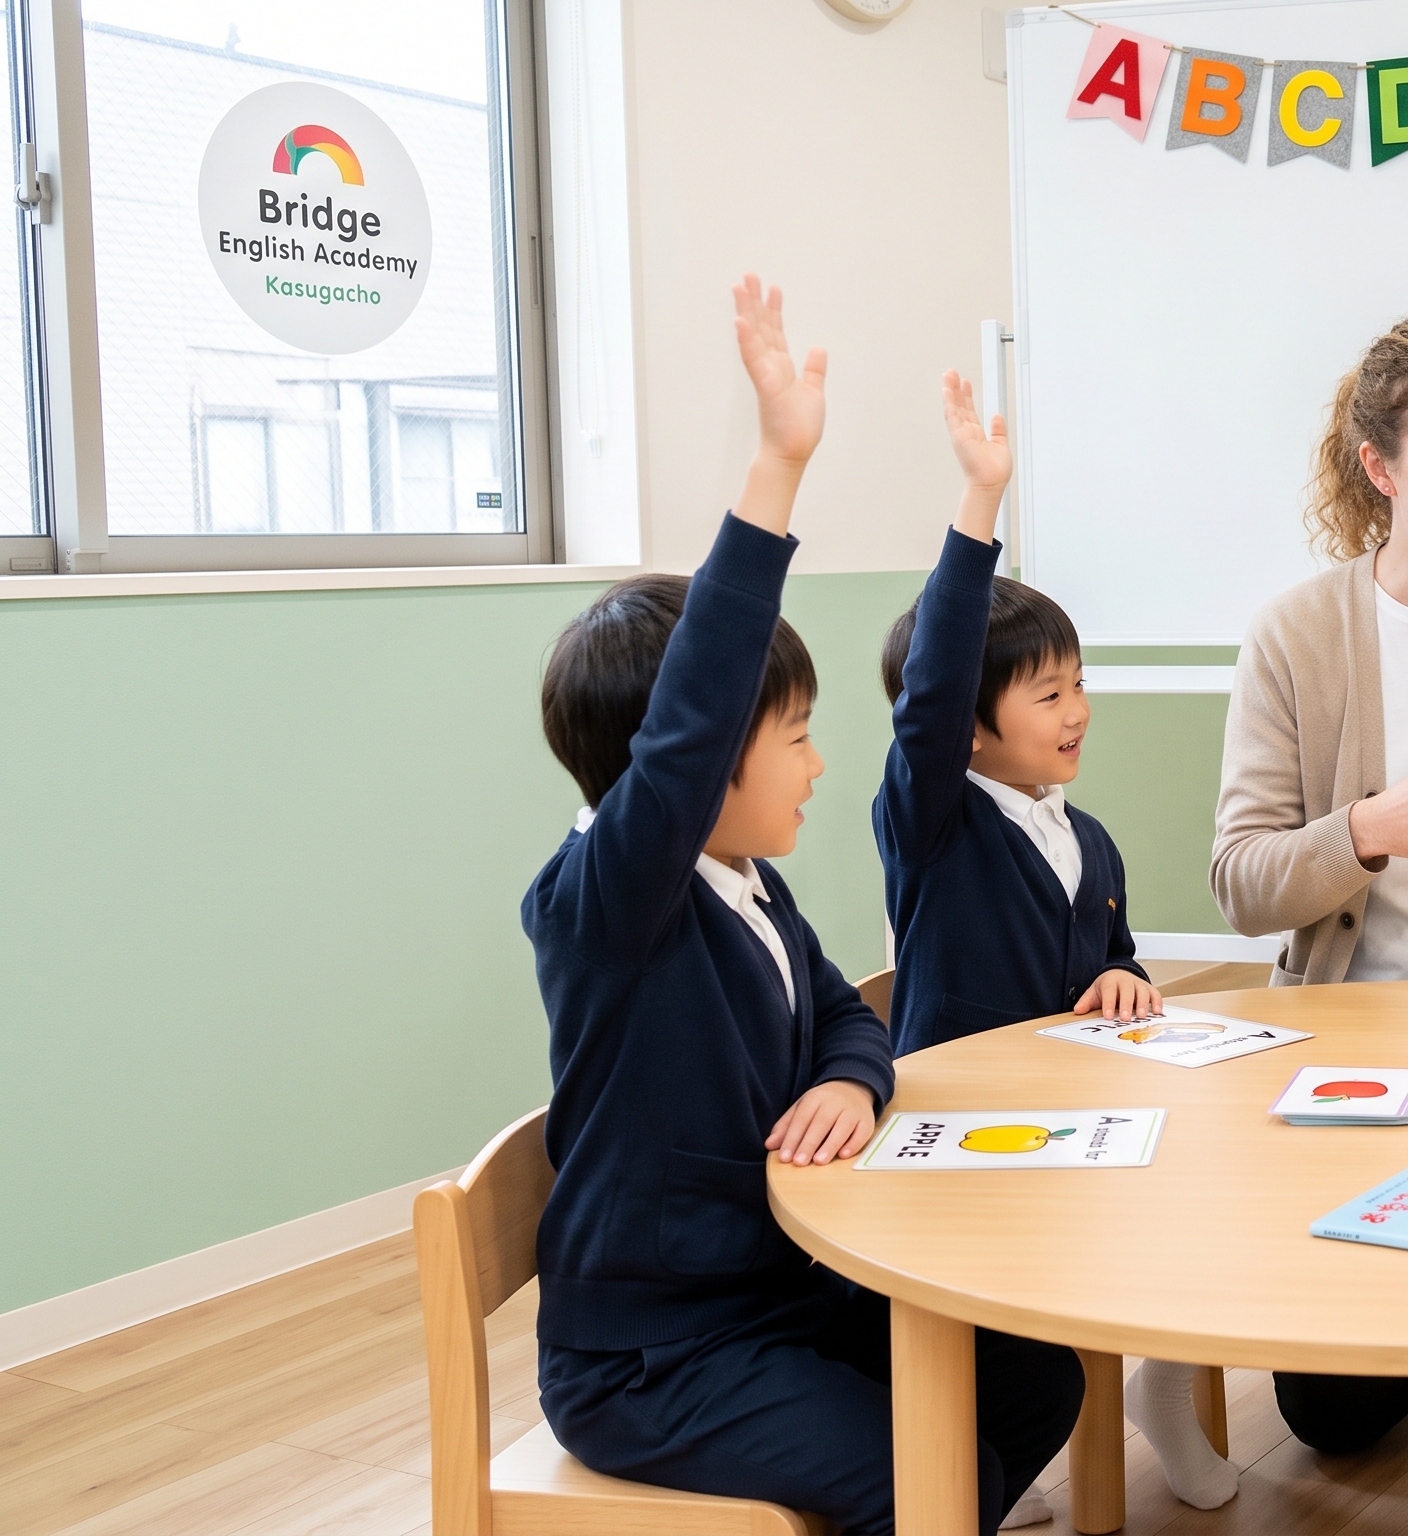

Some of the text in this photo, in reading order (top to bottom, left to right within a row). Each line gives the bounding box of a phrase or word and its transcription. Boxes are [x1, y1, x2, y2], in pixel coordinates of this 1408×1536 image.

[1076, 38, 1142, 121] A
[1180, 57, 1246, 136] B
[1279, 69, 1344, 147] C
[259, 188, 381, 243] Bridge
[219, 230, 418, 279] English Academy
[265, 275, 382, 305] Kasugacho
[896, 1122, 946, 1157] APPLE
[1098, 1116, 1133, 1125] A
